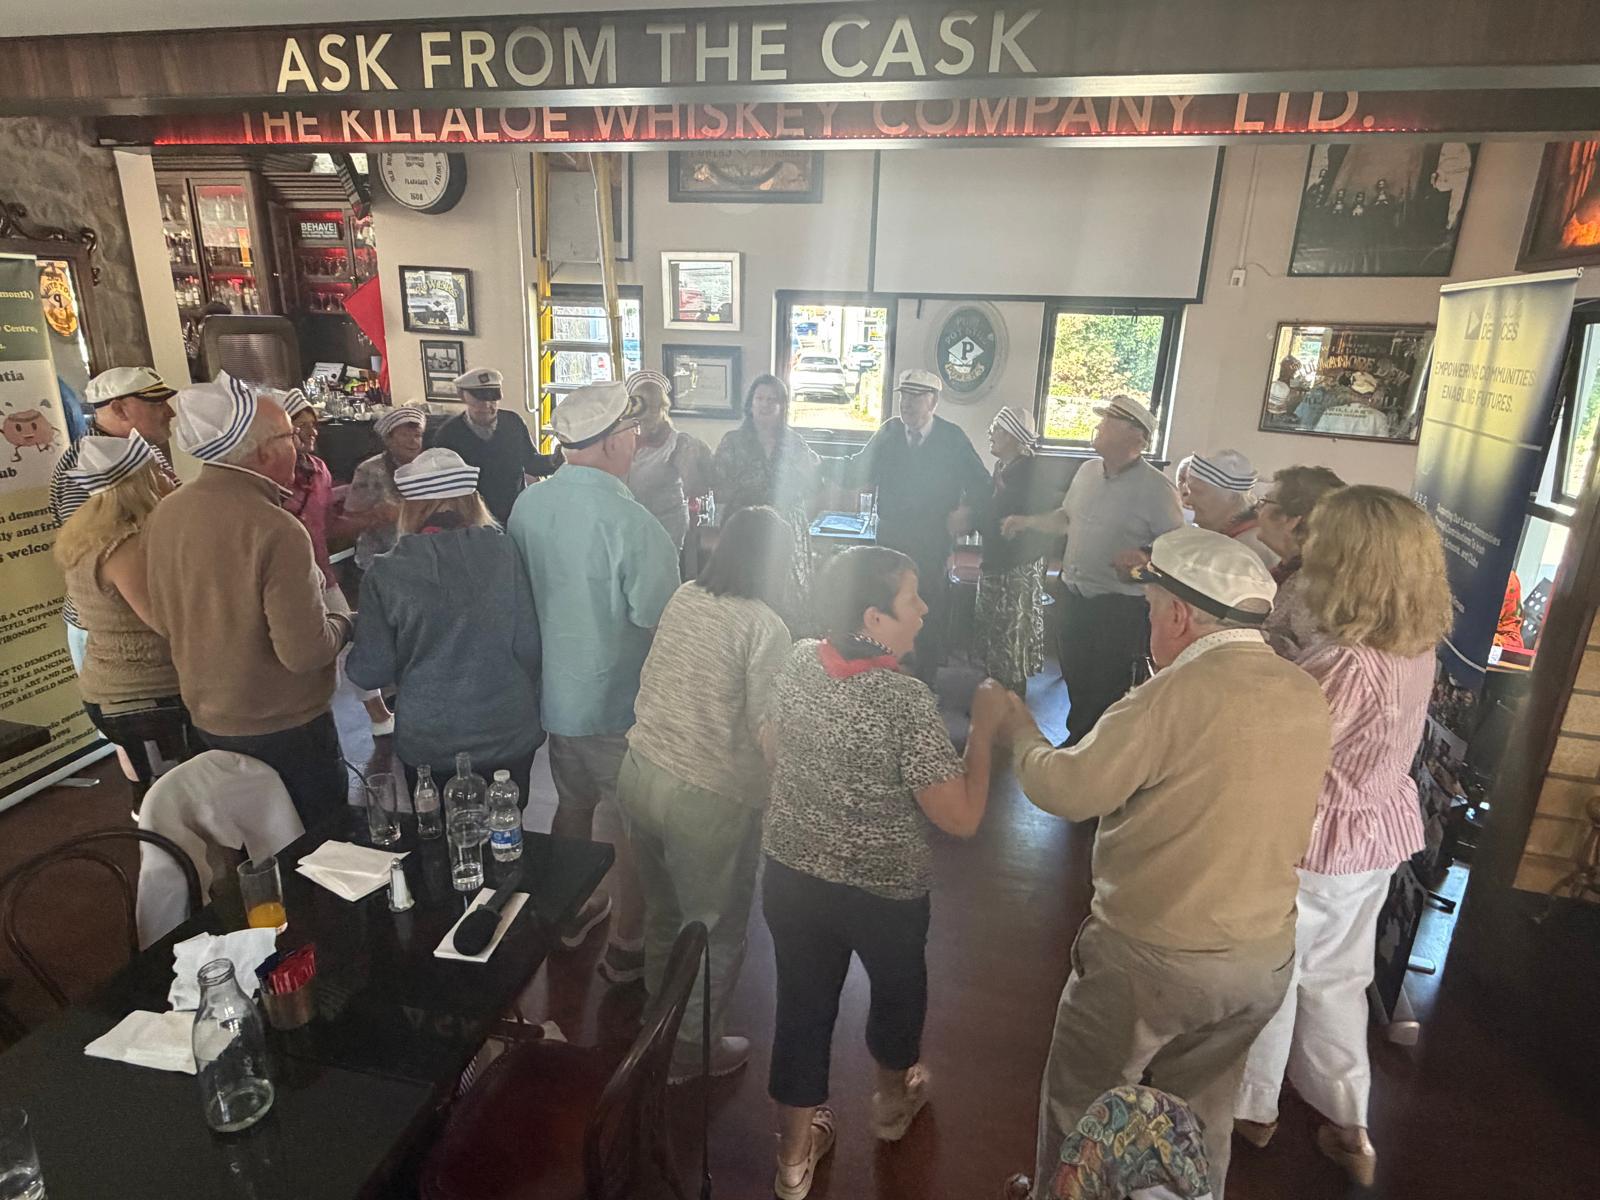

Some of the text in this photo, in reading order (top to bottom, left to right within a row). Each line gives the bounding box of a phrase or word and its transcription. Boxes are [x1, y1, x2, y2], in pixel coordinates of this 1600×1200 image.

[277, 9, 1042, 93] ASK FROM THE CASK
[340, 107, 570, 142] KILLALOE
[593, 102, 840, 139] WHISKEY
[873, 96, 1195, 136] COMPANY
[961, 341, 975, 361] P
[8, 507, 52, 522] dement
[16, 524, 39, 538] and
[24, 647, 67, 668] DEMENTIA
